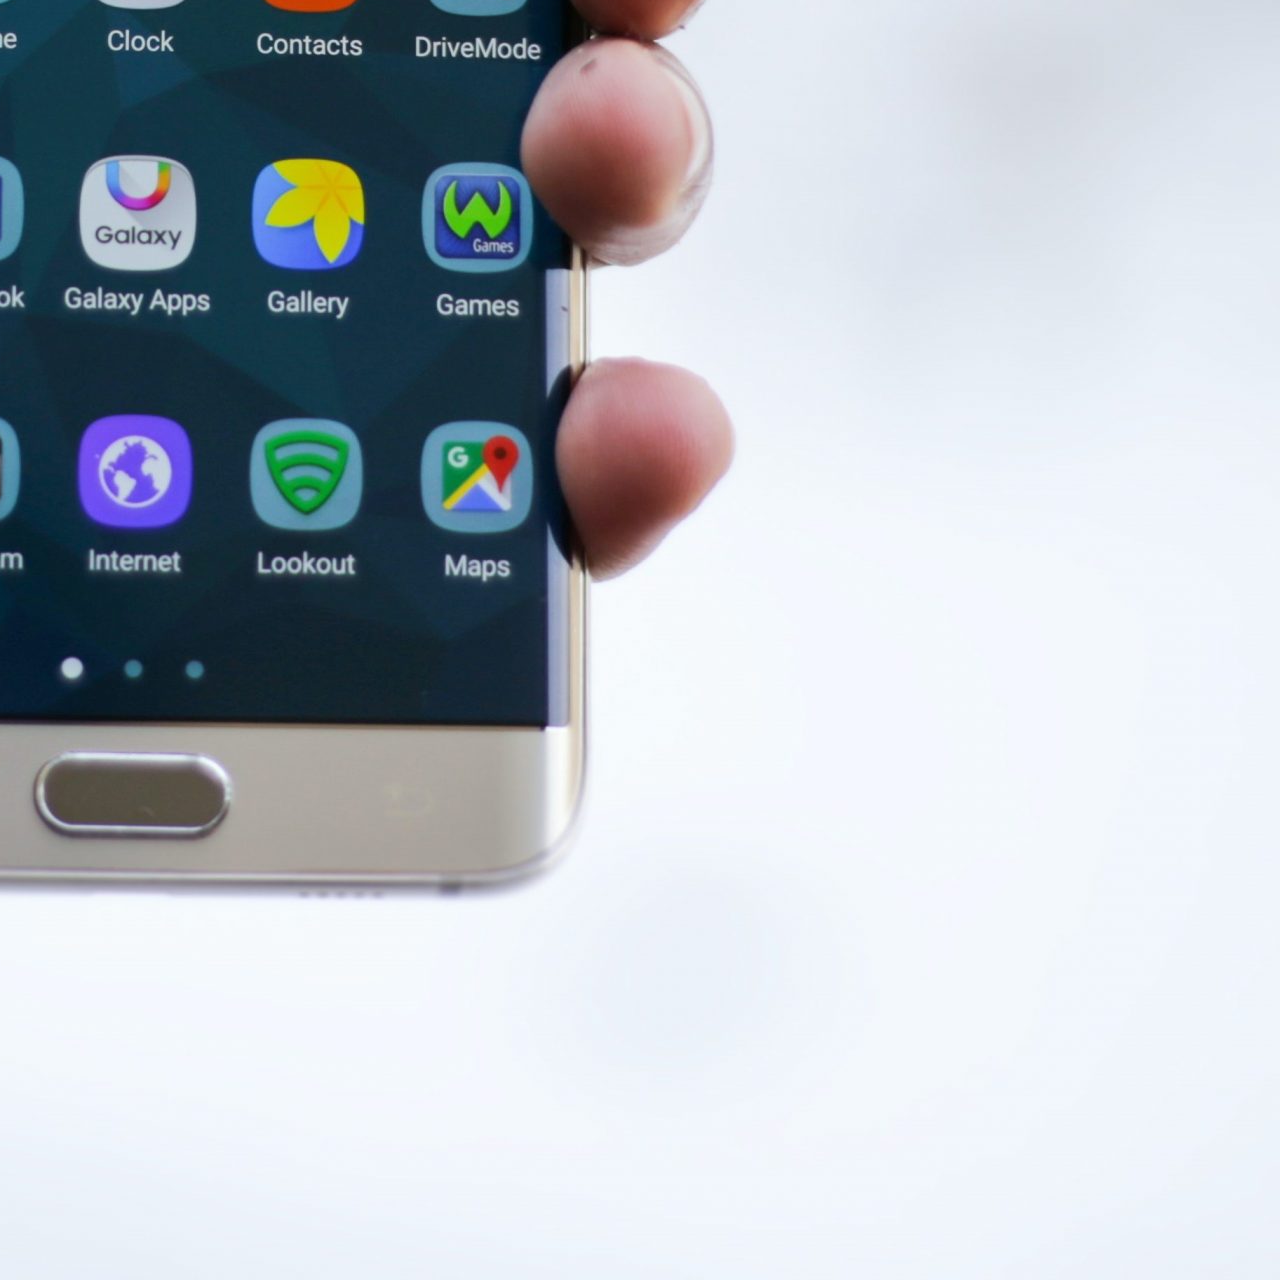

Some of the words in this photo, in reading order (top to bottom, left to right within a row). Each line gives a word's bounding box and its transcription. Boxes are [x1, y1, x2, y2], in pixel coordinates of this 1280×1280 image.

[107, 30, 174, 52] Clock
[256, 33, 363, 56] Contacts
[414, 36, 541, 60] DriveMode
[95, 225, 182, 250] Galaxy
[473, 238, 514, 254] Games
[64, 287, 143, 314] Galaxy
[150, 289, 210, 315] Apps
[267, 290, 349, 318] Gallery
[436, 294, 519, 317] Games
[88, 549, 181, 572] Internet
[257, 551, 356, 574] Lookout
[445, 554, 511, 580] Maps
